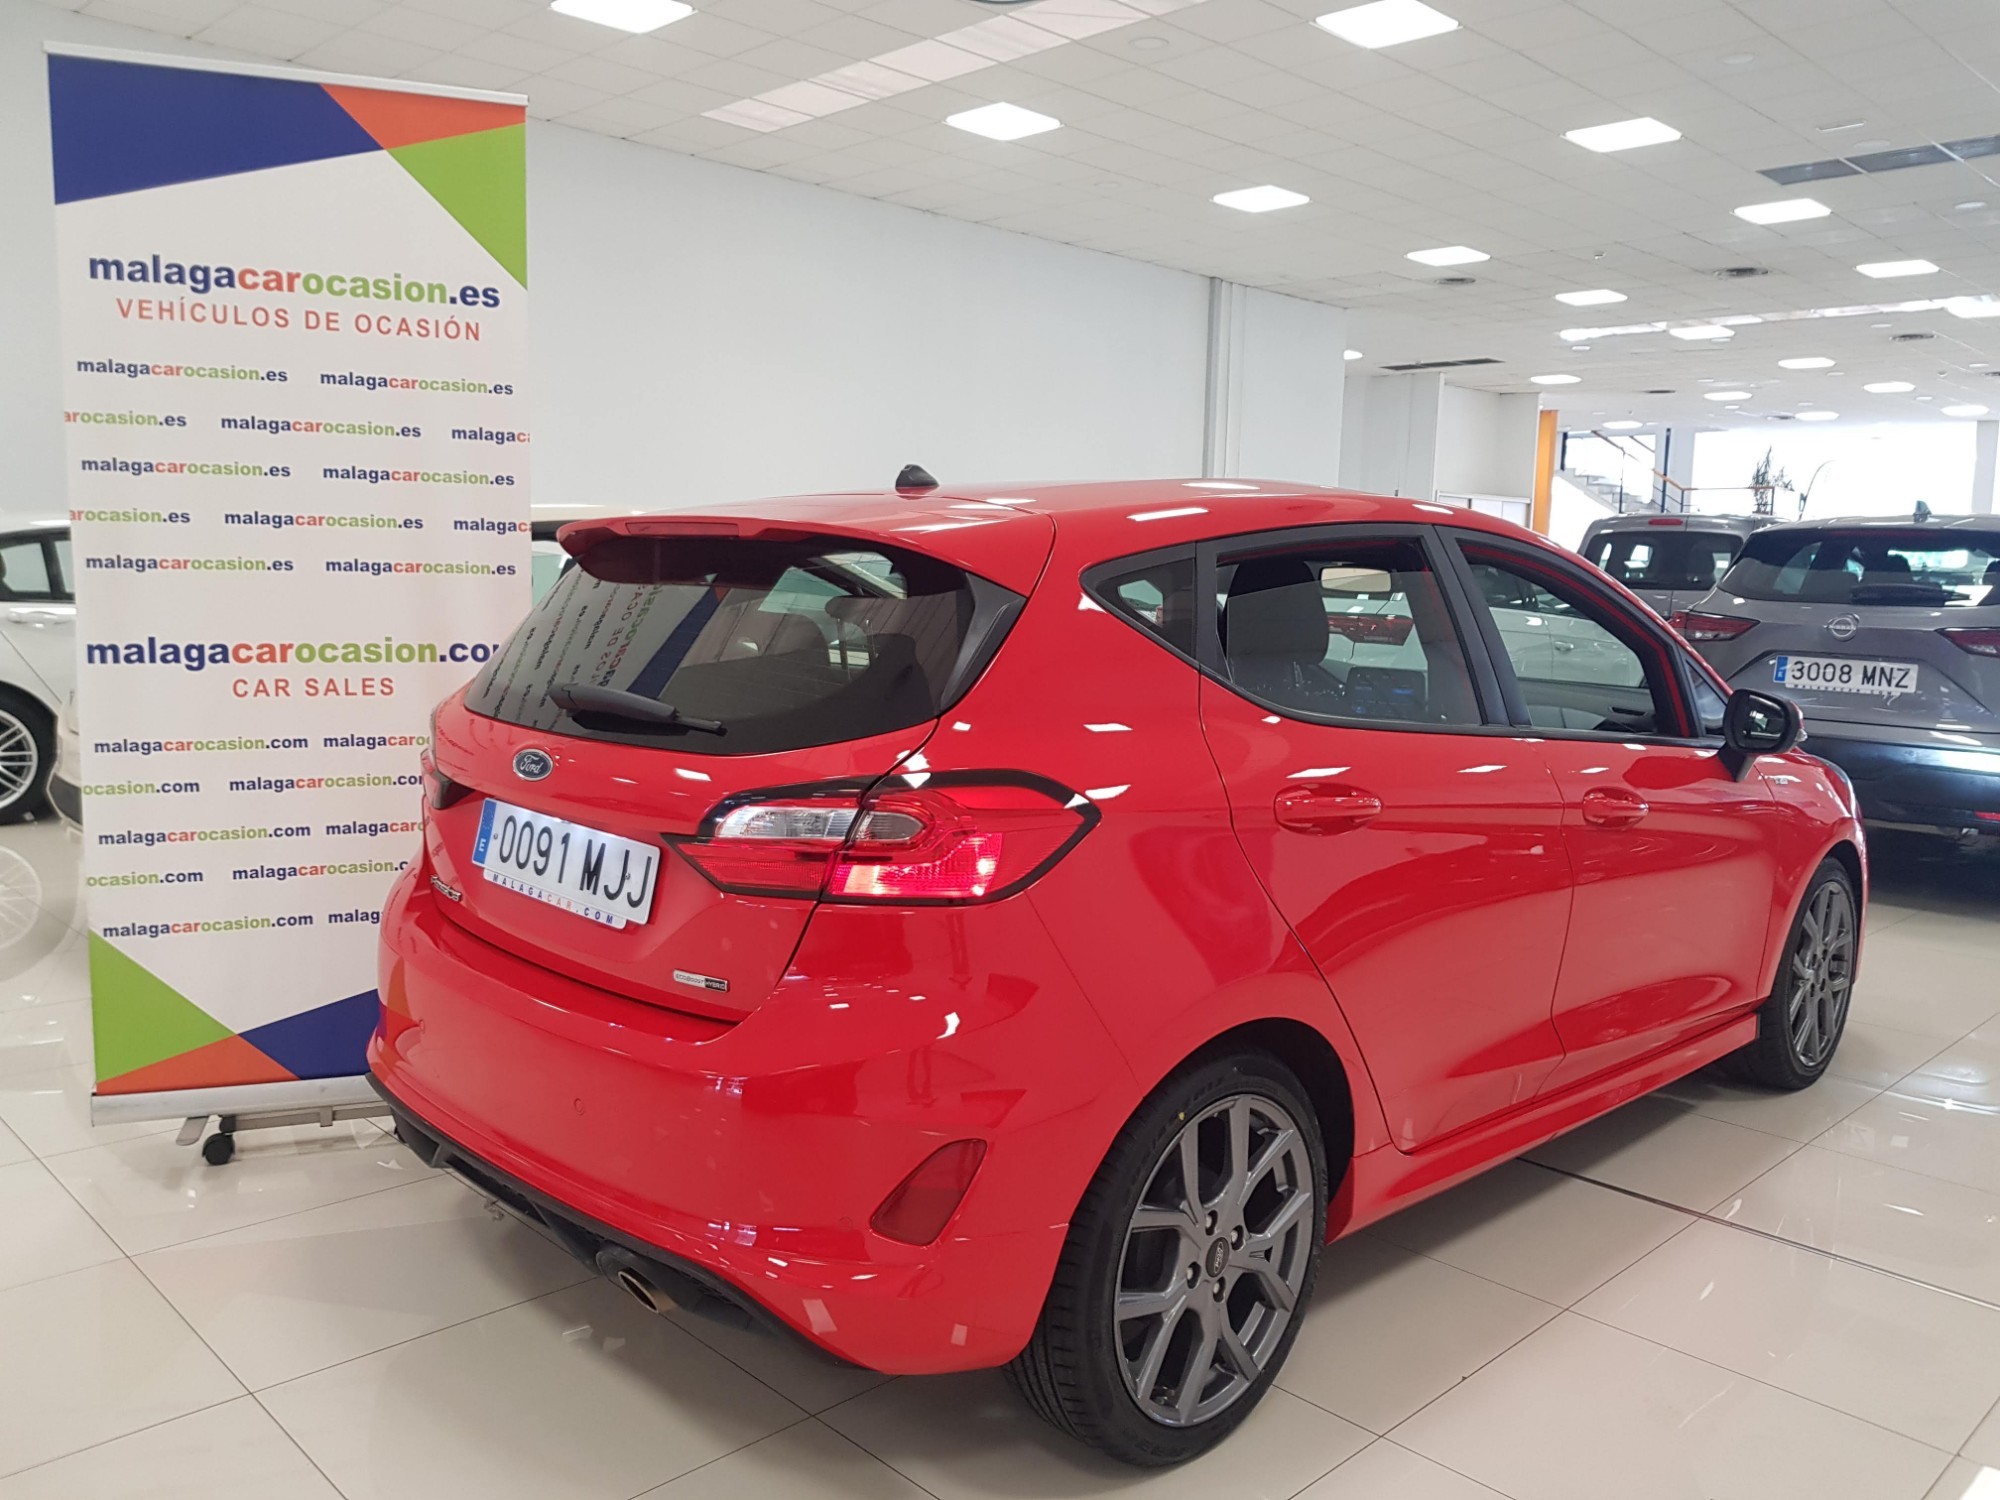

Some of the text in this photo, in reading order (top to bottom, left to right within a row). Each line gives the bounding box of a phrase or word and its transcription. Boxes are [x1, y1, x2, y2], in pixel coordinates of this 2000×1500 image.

[89, 254, 501, 309] malagacarocasion.es
[116, 296, 481, 341] VEHÍCULOS DE OCASIÓN
[77, 358, 513, 395] malagacarocasion.es malagacarocasion.es
[221, 415, 421, 438] malagacarocasion.es
[452, 427, 530, 445] malagac
[81, 457, 514, 486] malagacarocasion.es malagacarocasion.es
[224, 510, 423, 530] malagacarocasion.es
[86, 554, 517, 577] malagacarocasion.es malagacarocasion.es
[87, 636, 499, 672] malagacarocasion.co
[232, 677, 395, 698] CAR SALES
[1791, 660, 1852, 684] 3008
[1861, 665, 1911, 689] MNZ
[94, 736, 309, 756] malagacarocasion.com
[520, 754, 544, 774] Ford
[83, 773, 422, 796] ocasion.com malagacarocasion.co
[98, 825, 311, 847] malagacarocasion.com
[478, 815, 652, 908] E 0091 MJJ
[87, 872, 204, 887] ocasion.com
[103, 909, 382, 938] malagacarocasion.com malag
